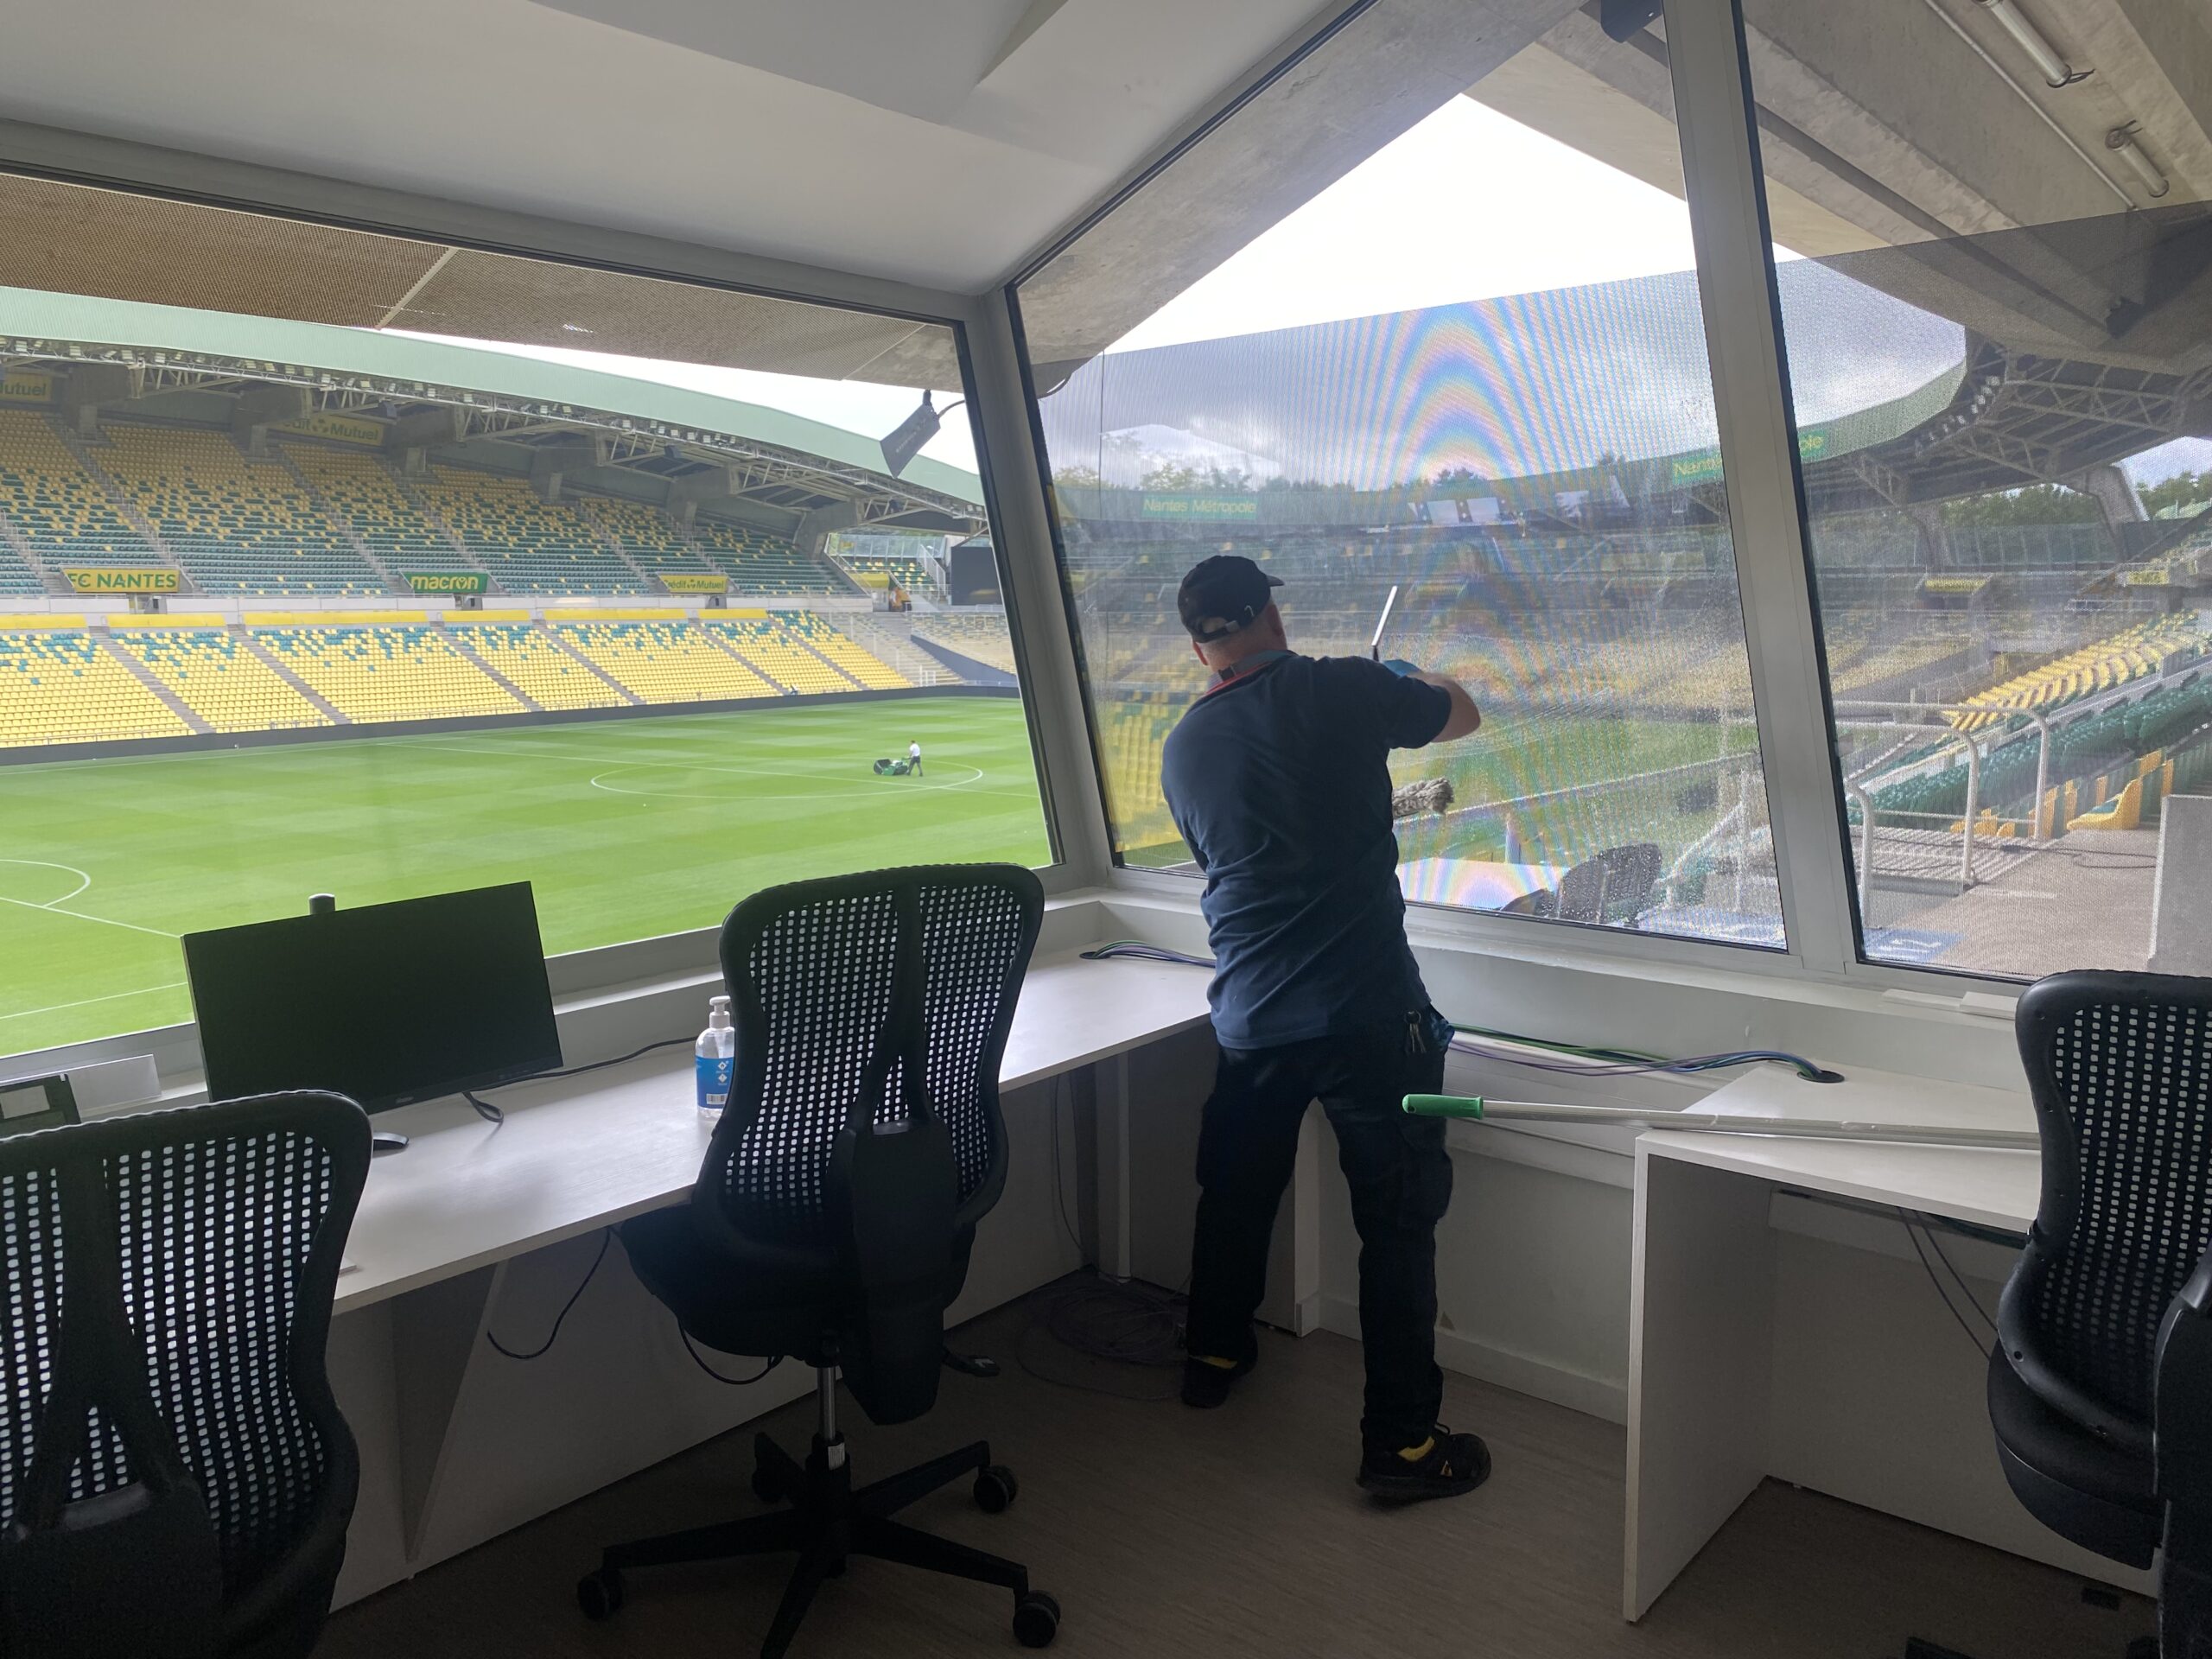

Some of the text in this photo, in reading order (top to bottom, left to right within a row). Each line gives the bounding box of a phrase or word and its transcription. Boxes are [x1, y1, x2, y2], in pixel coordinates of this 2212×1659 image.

[329, 423, 379, 441] Mutuel
[1144, 499, 1188, 512] Nantes
[96, 573, 176, 588] NANTES
[410, 575, 479, 589] macron
